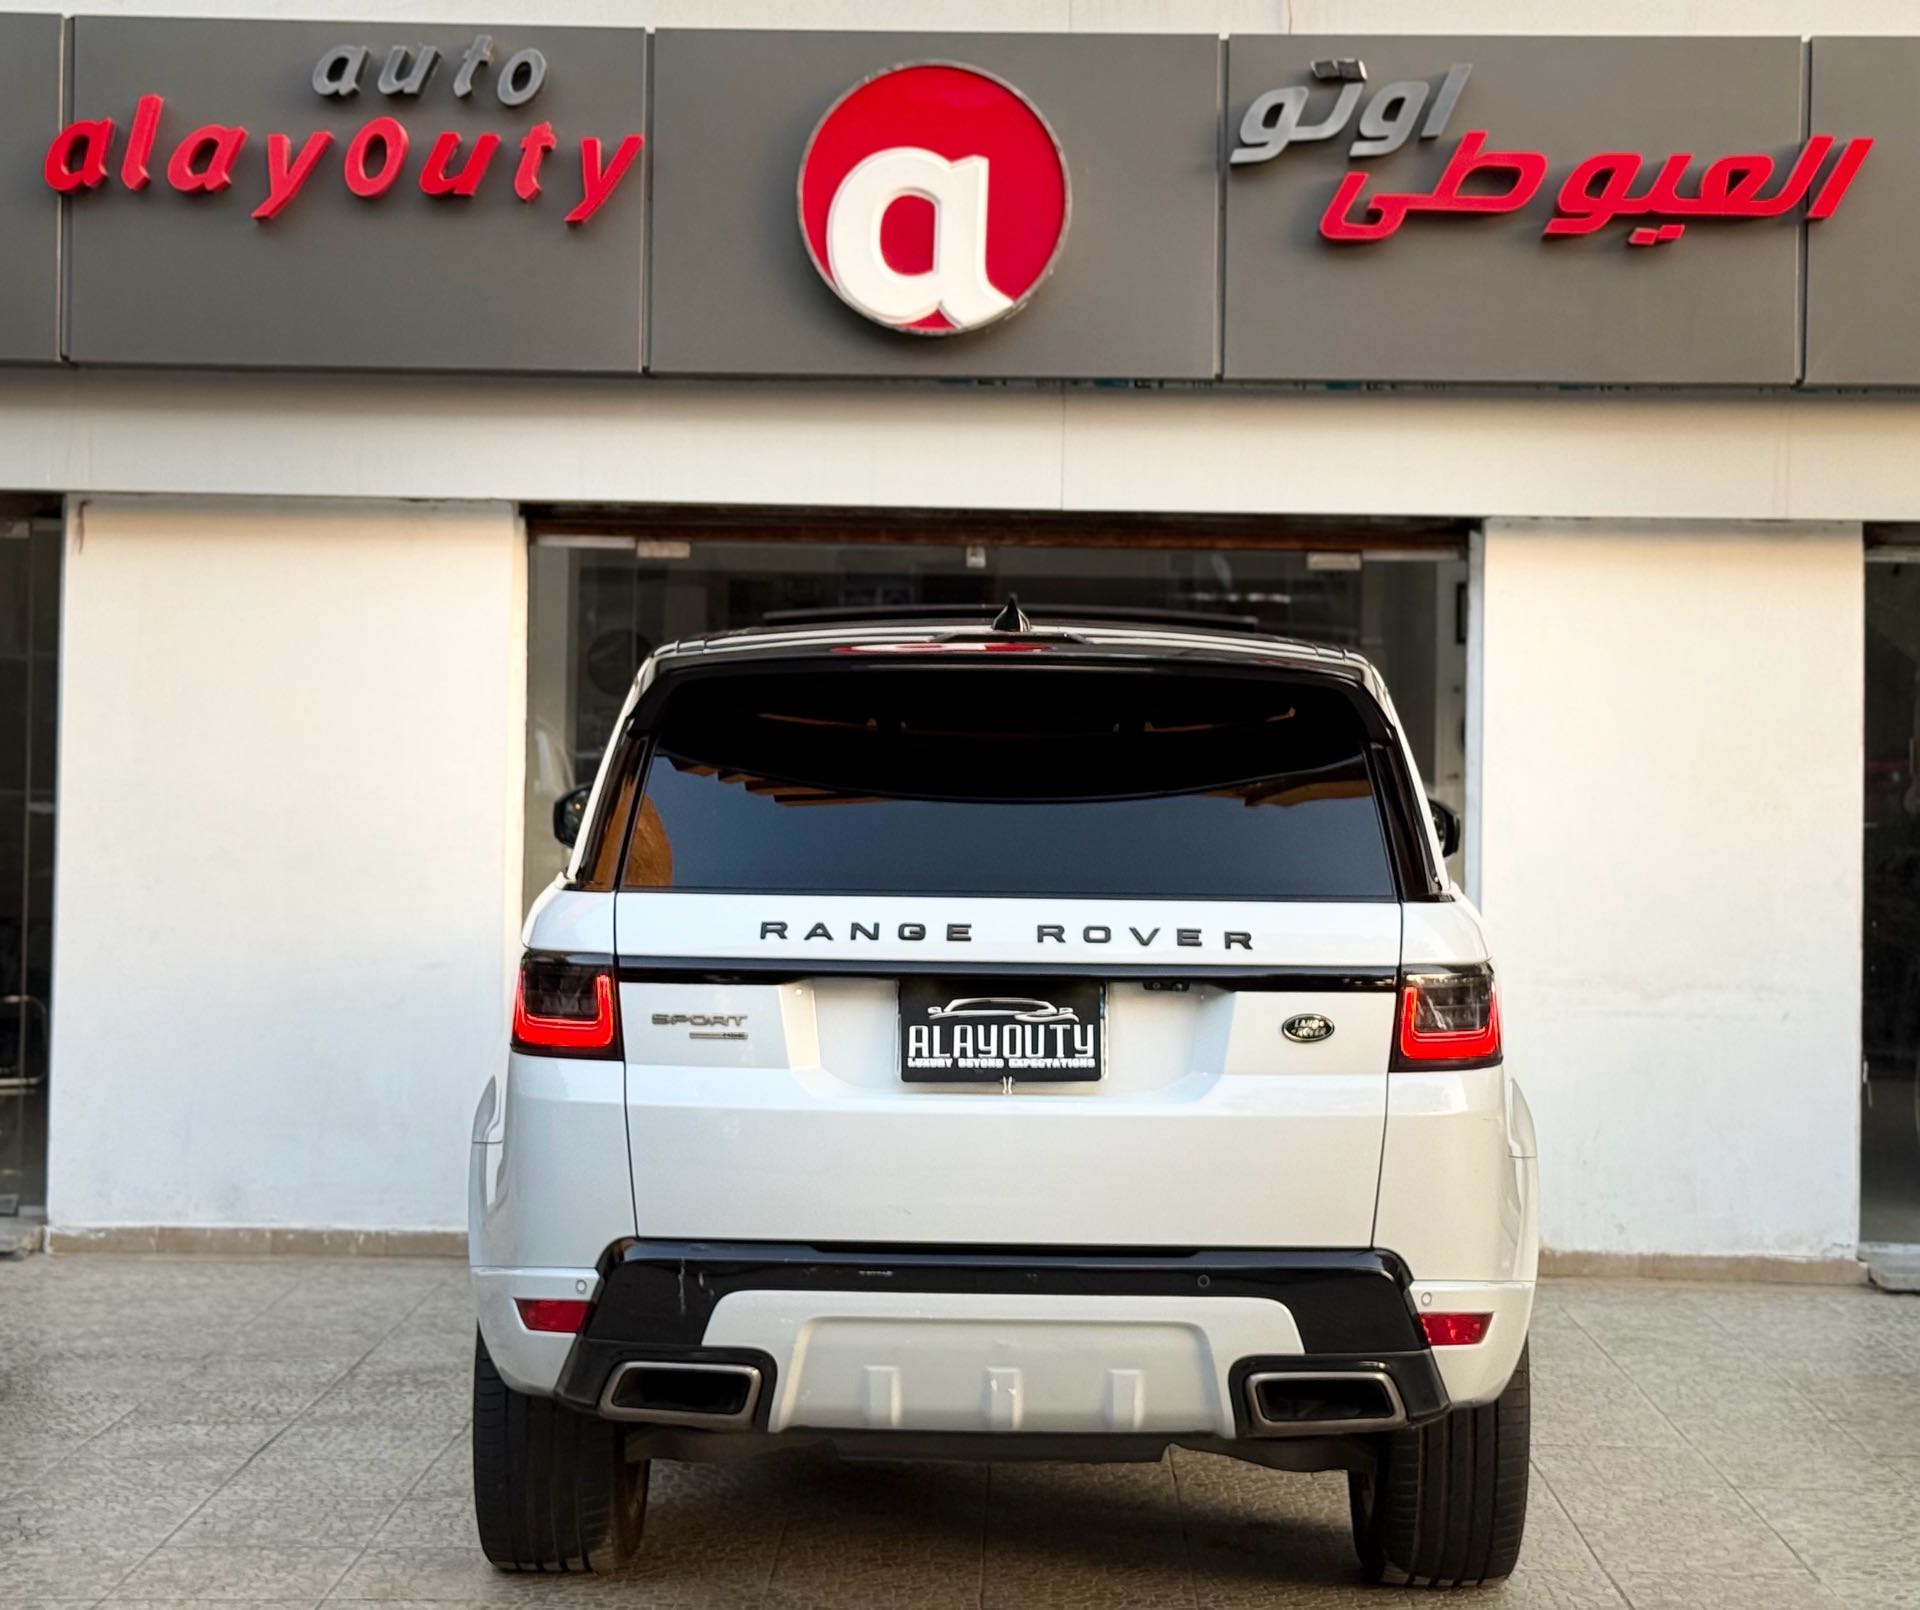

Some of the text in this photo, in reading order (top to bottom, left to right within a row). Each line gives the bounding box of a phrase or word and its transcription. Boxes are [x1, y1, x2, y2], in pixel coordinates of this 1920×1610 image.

[312, 34, 547, 106] auto
[1230, 58, 1472, 164] اوتو
[44, 94, 643, 224] alayouty
[826, 146, 1015, 329] a
[760, 921, 1253, 949] RANGE ROVER
[652, 1014, 748, 1026] SPORT
[908, 1024, 1094, 1058] ALAYOUTY
[907, 1058, 1096, 1068] LUXURY BEYOND EXPECTATIONS
